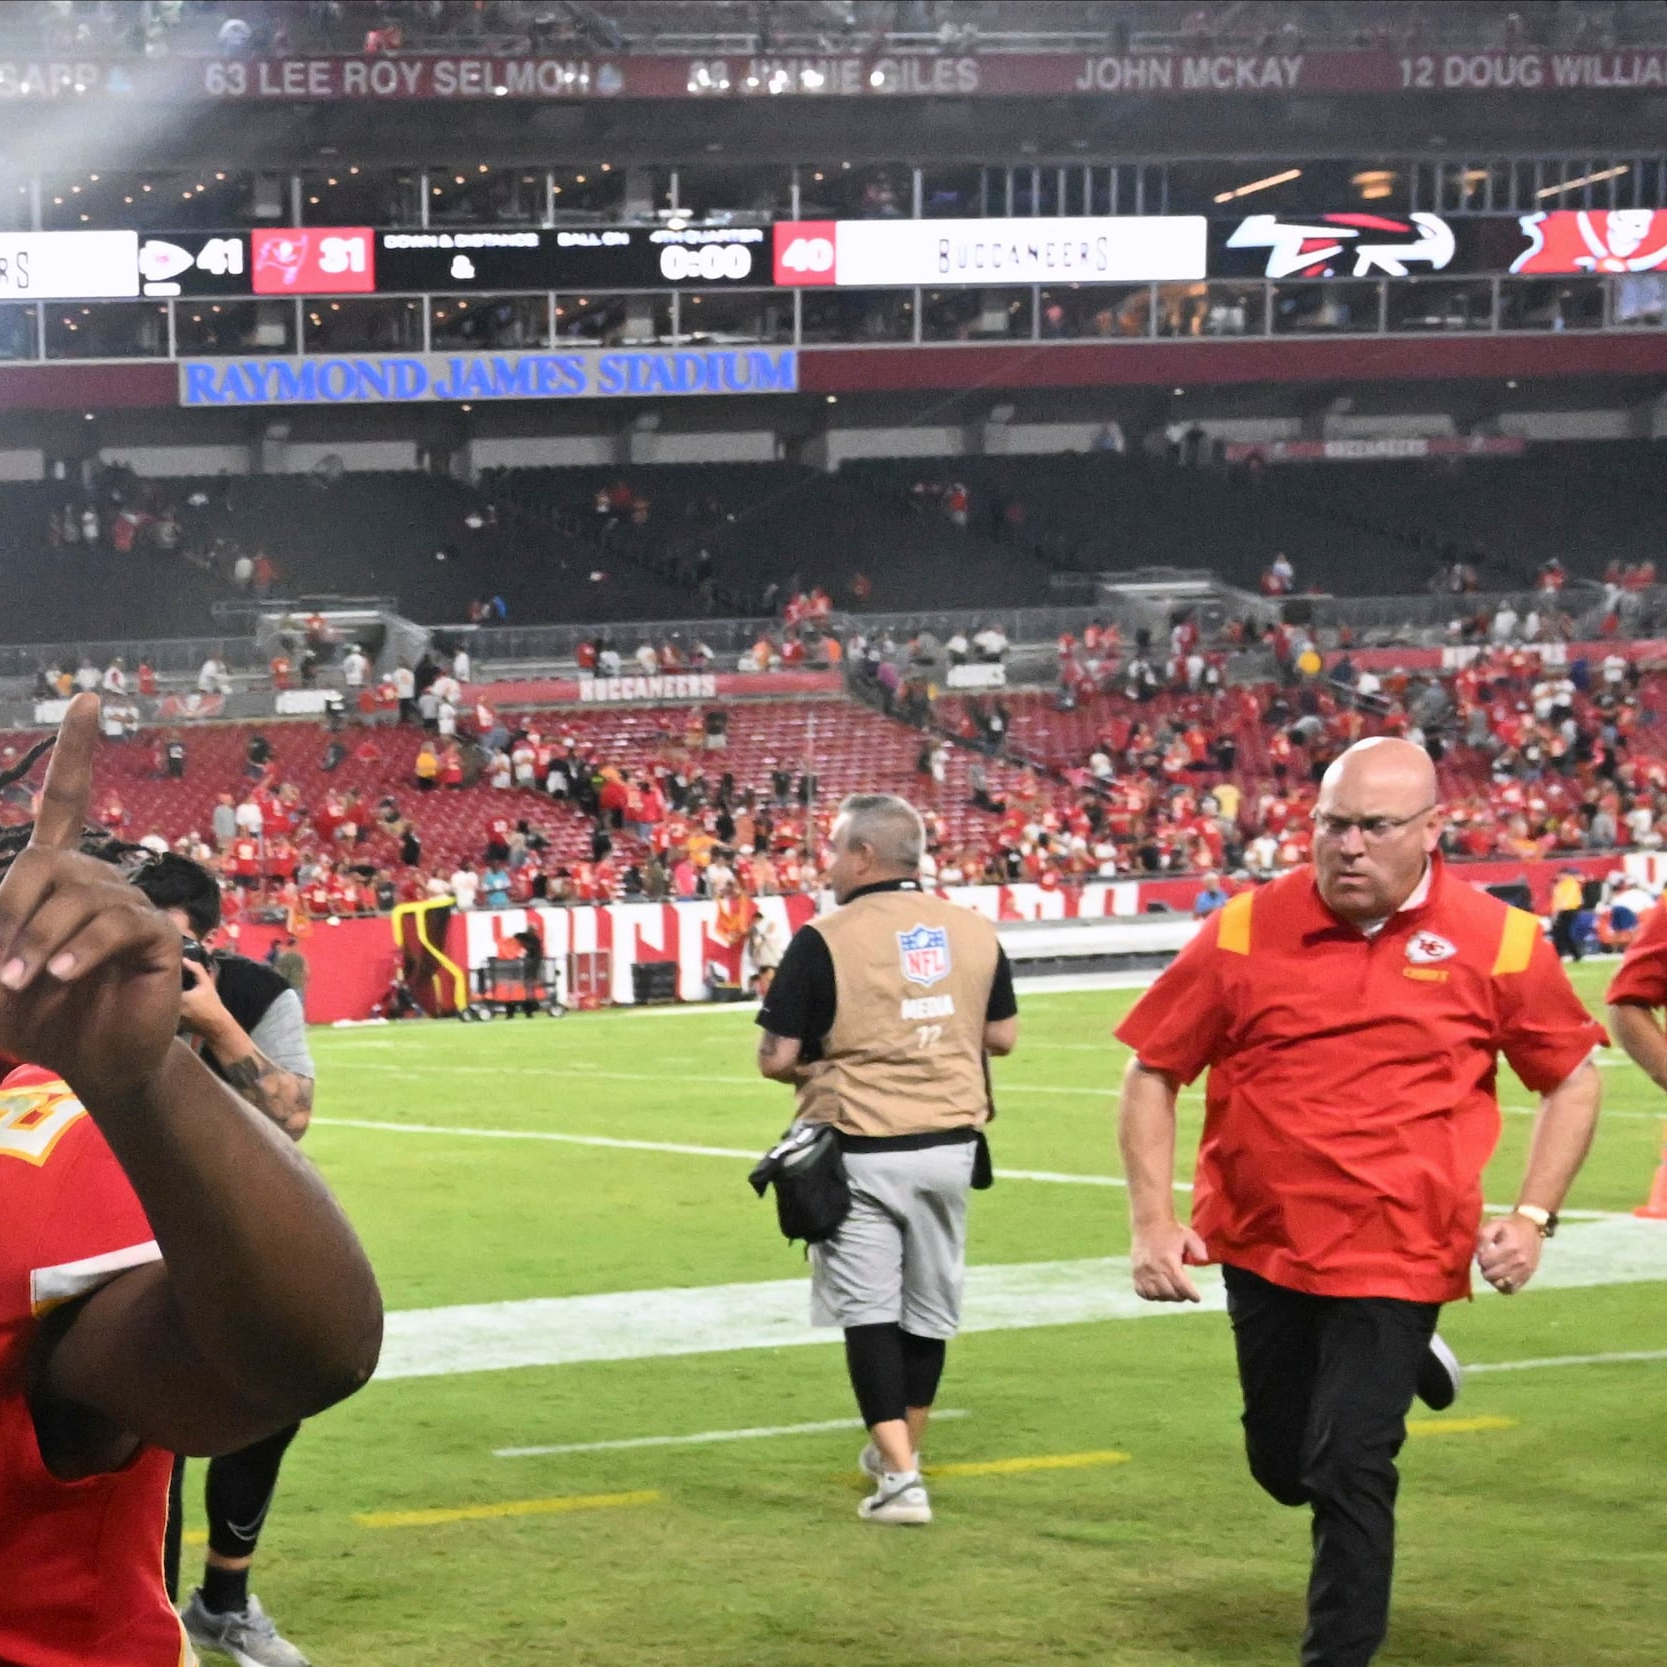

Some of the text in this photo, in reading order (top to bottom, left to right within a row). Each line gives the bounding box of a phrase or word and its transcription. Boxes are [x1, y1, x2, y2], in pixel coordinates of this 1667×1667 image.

[204, 60, 590, 96] 63 LEE ROY SELMON
[870, 57, 981, 94] GILES
[1074, 55, 1304, 90] JOHN MCKAY
[1399, 55, 1436, 88] 12
[1443, 55, 1544, 88] DOUG
[196, 238, 244, 276] 41
[318, 238, 367, 273] 31
[781, 238, 834, 272] 40
[938, 236, 1108, 274] BUCCANEERS
[184, 350, 799, 401] RAYMOND JAMES STADIUM
[907, 949, 946, 977] NFL
